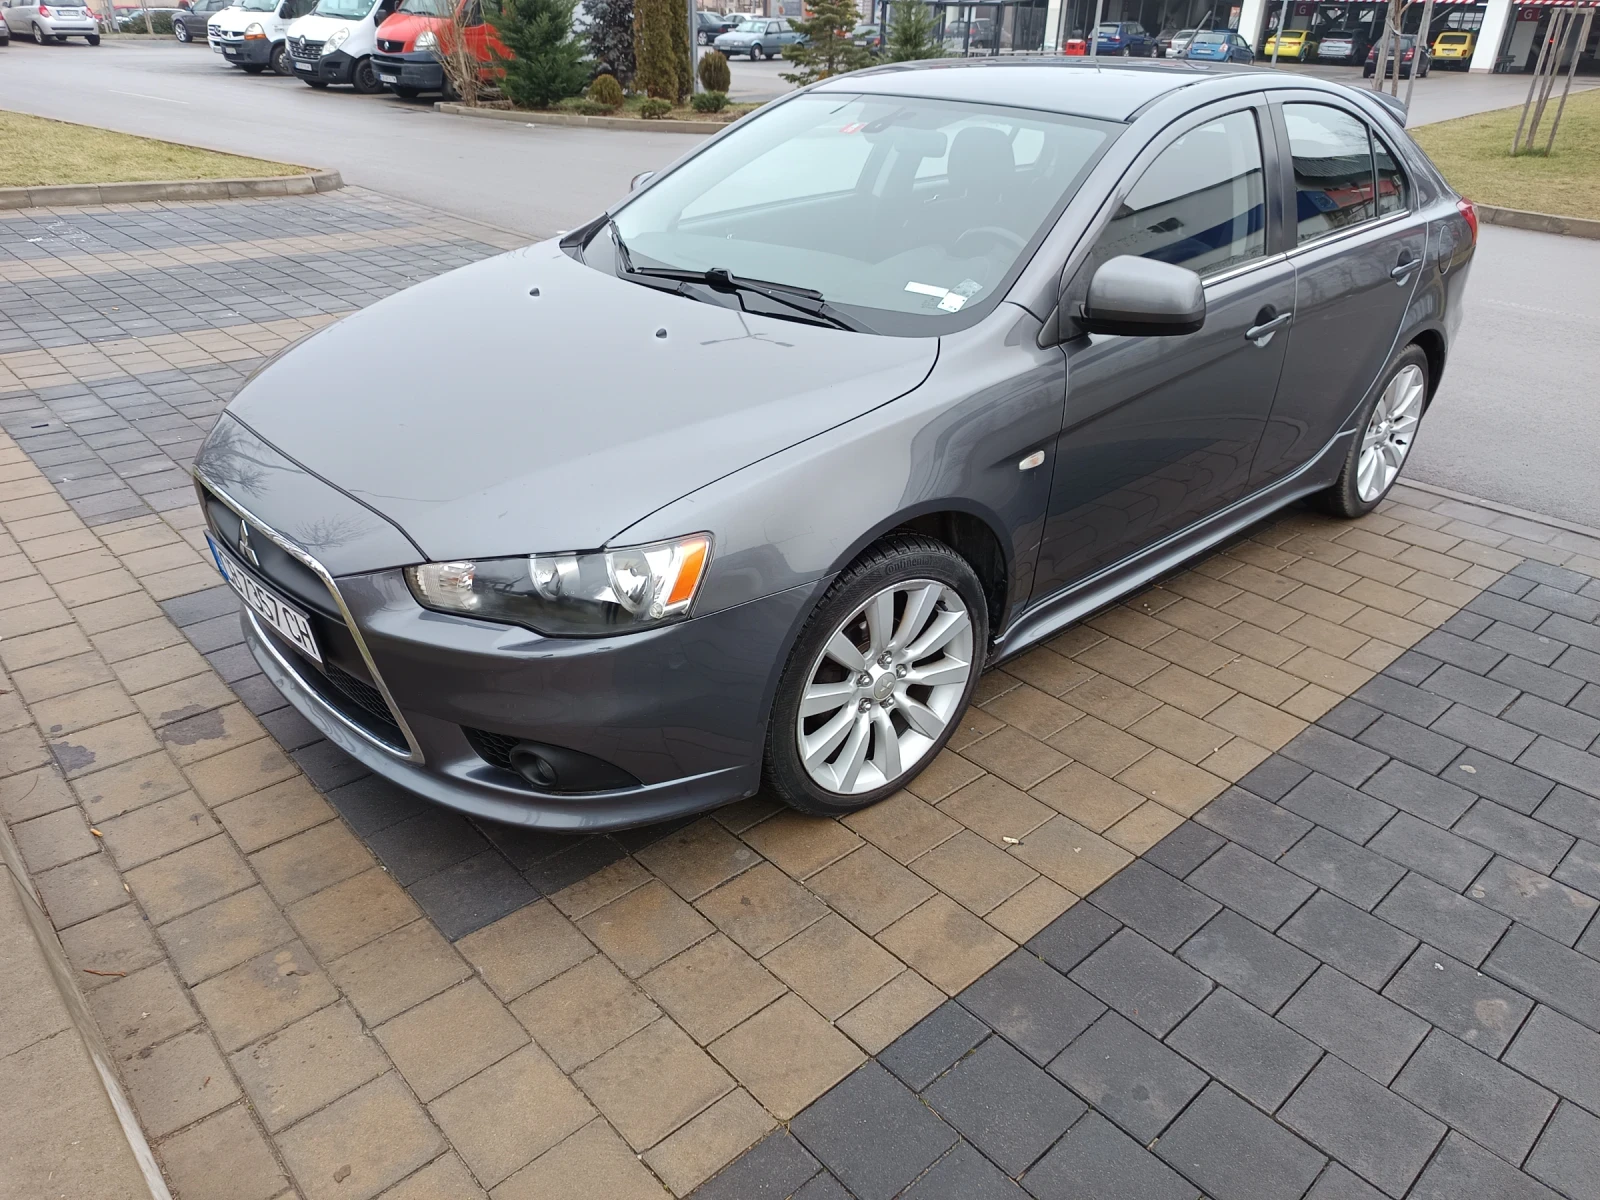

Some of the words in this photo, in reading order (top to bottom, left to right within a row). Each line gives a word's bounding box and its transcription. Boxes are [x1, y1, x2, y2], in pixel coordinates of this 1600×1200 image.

[1299, 5, 1306, 15] G
[1523, 9, 1533, 20] G
[885, 556, 933, 575] Continental
[236, 569, 280, 627] 7357
[282, 606, 316, 654] CH
